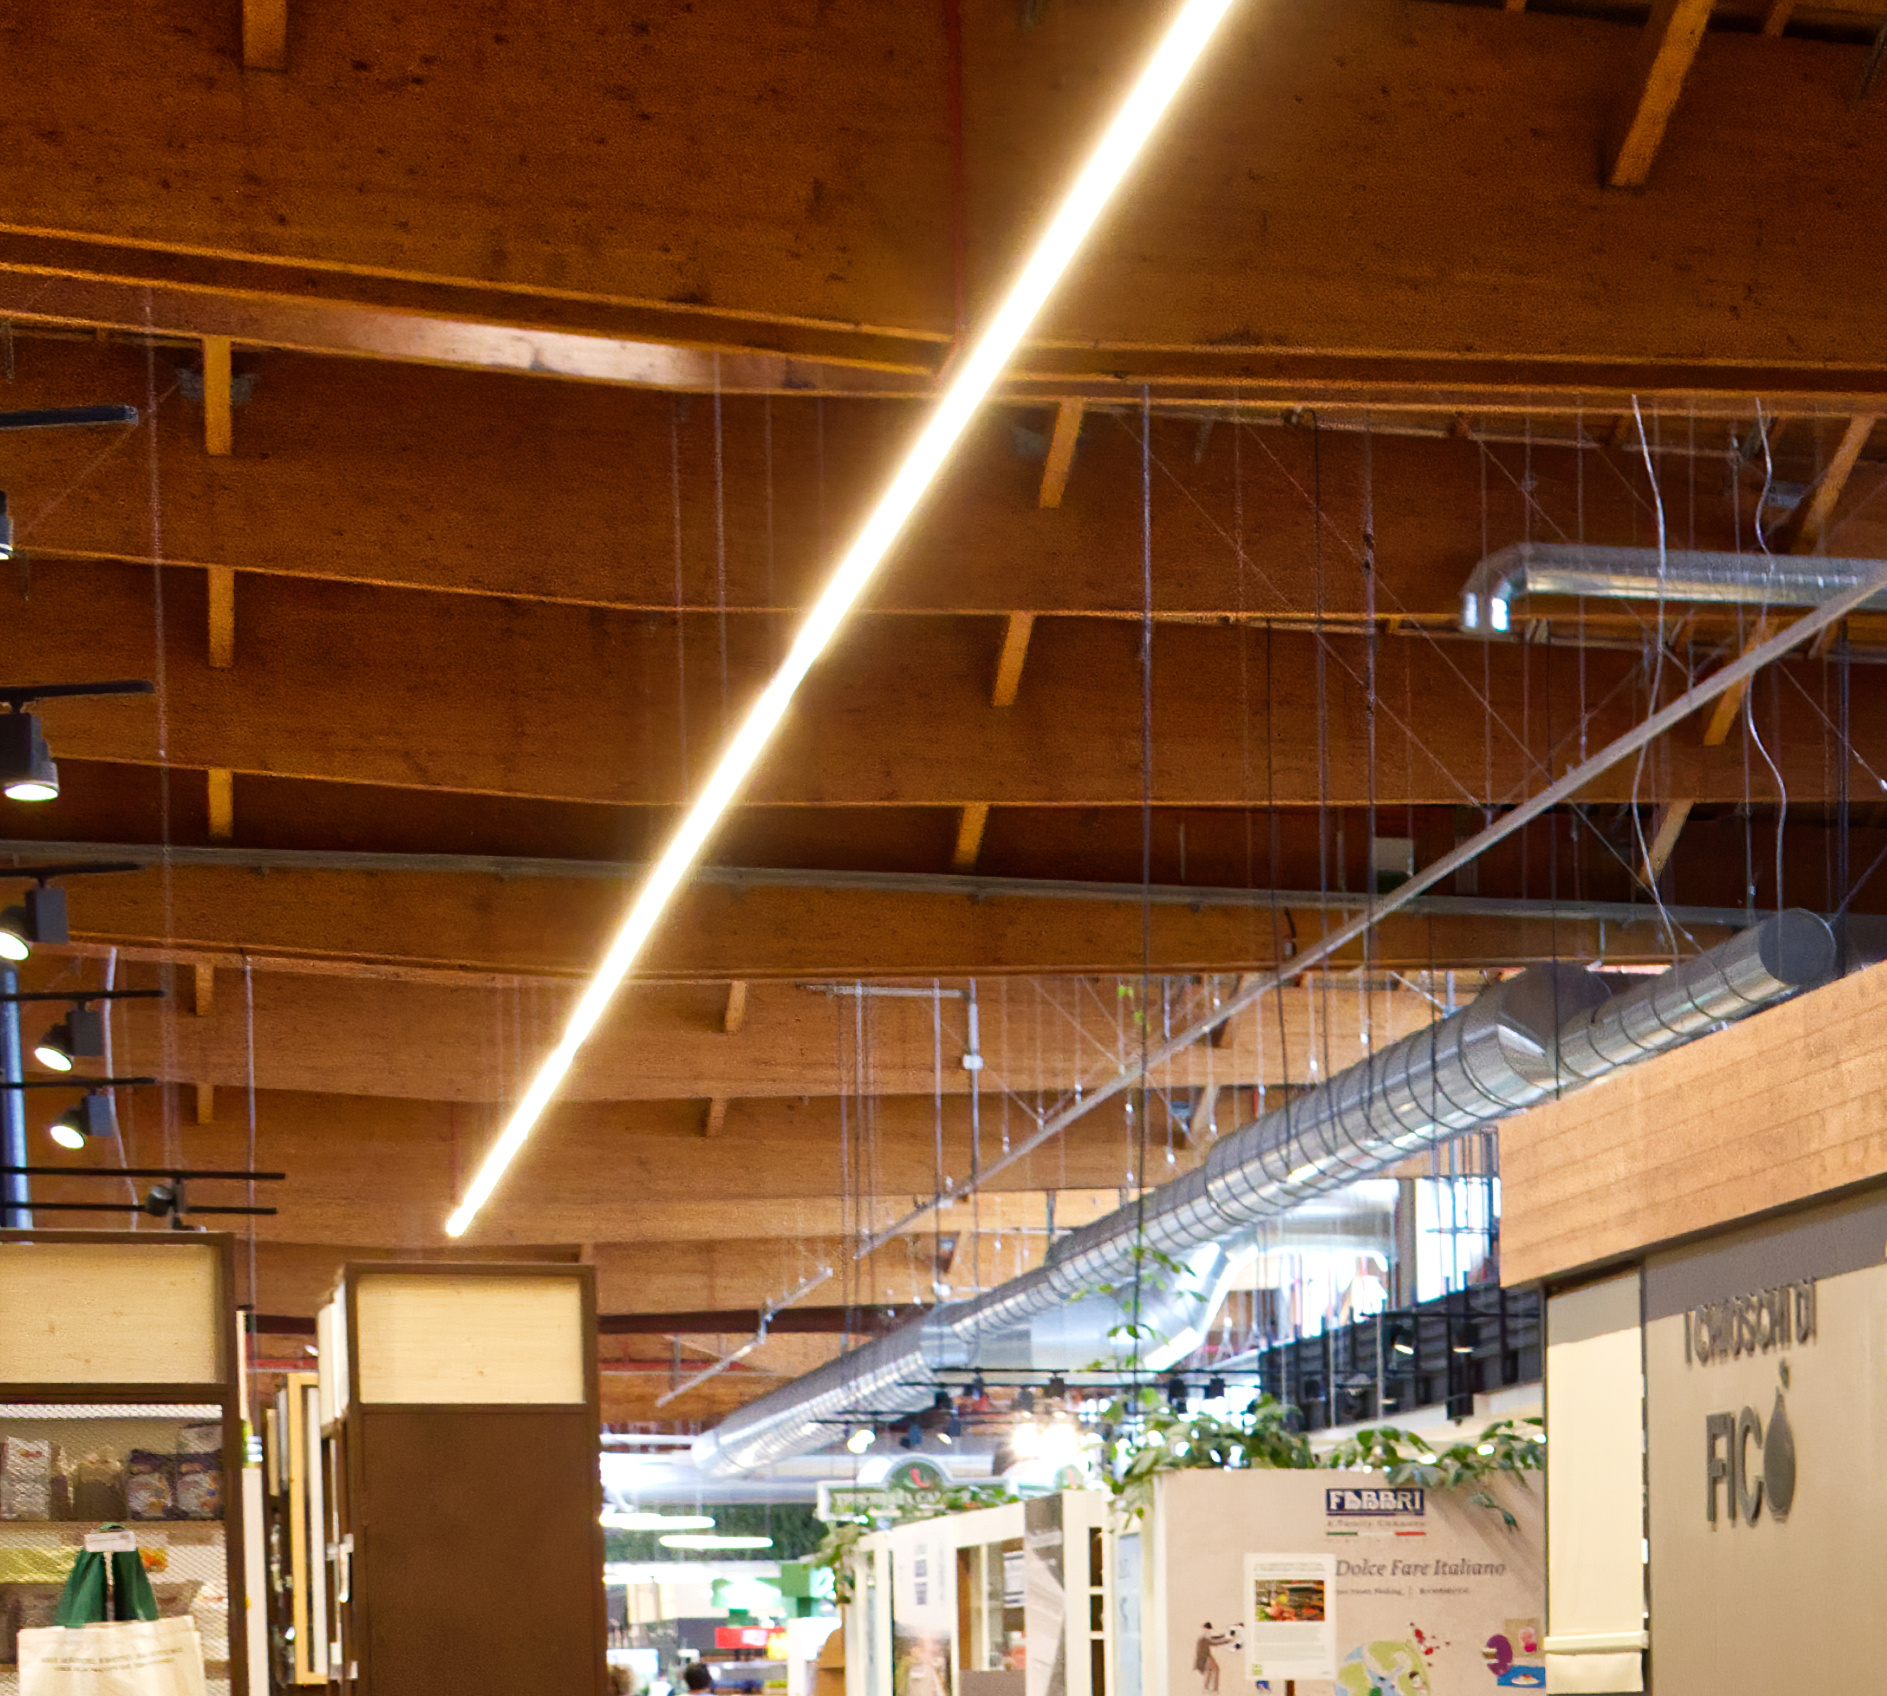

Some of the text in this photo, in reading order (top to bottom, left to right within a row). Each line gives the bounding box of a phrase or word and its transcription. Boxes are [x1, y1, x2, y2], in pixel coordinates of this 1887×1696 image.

[1329, 1489, 1422, 1511] FABBRI
[1336, 1558, 1386, 1577] Dolce
[1391, 1559, 1432, 1577] Fare
[1434, 1557, 1506, 1577] Italiano
